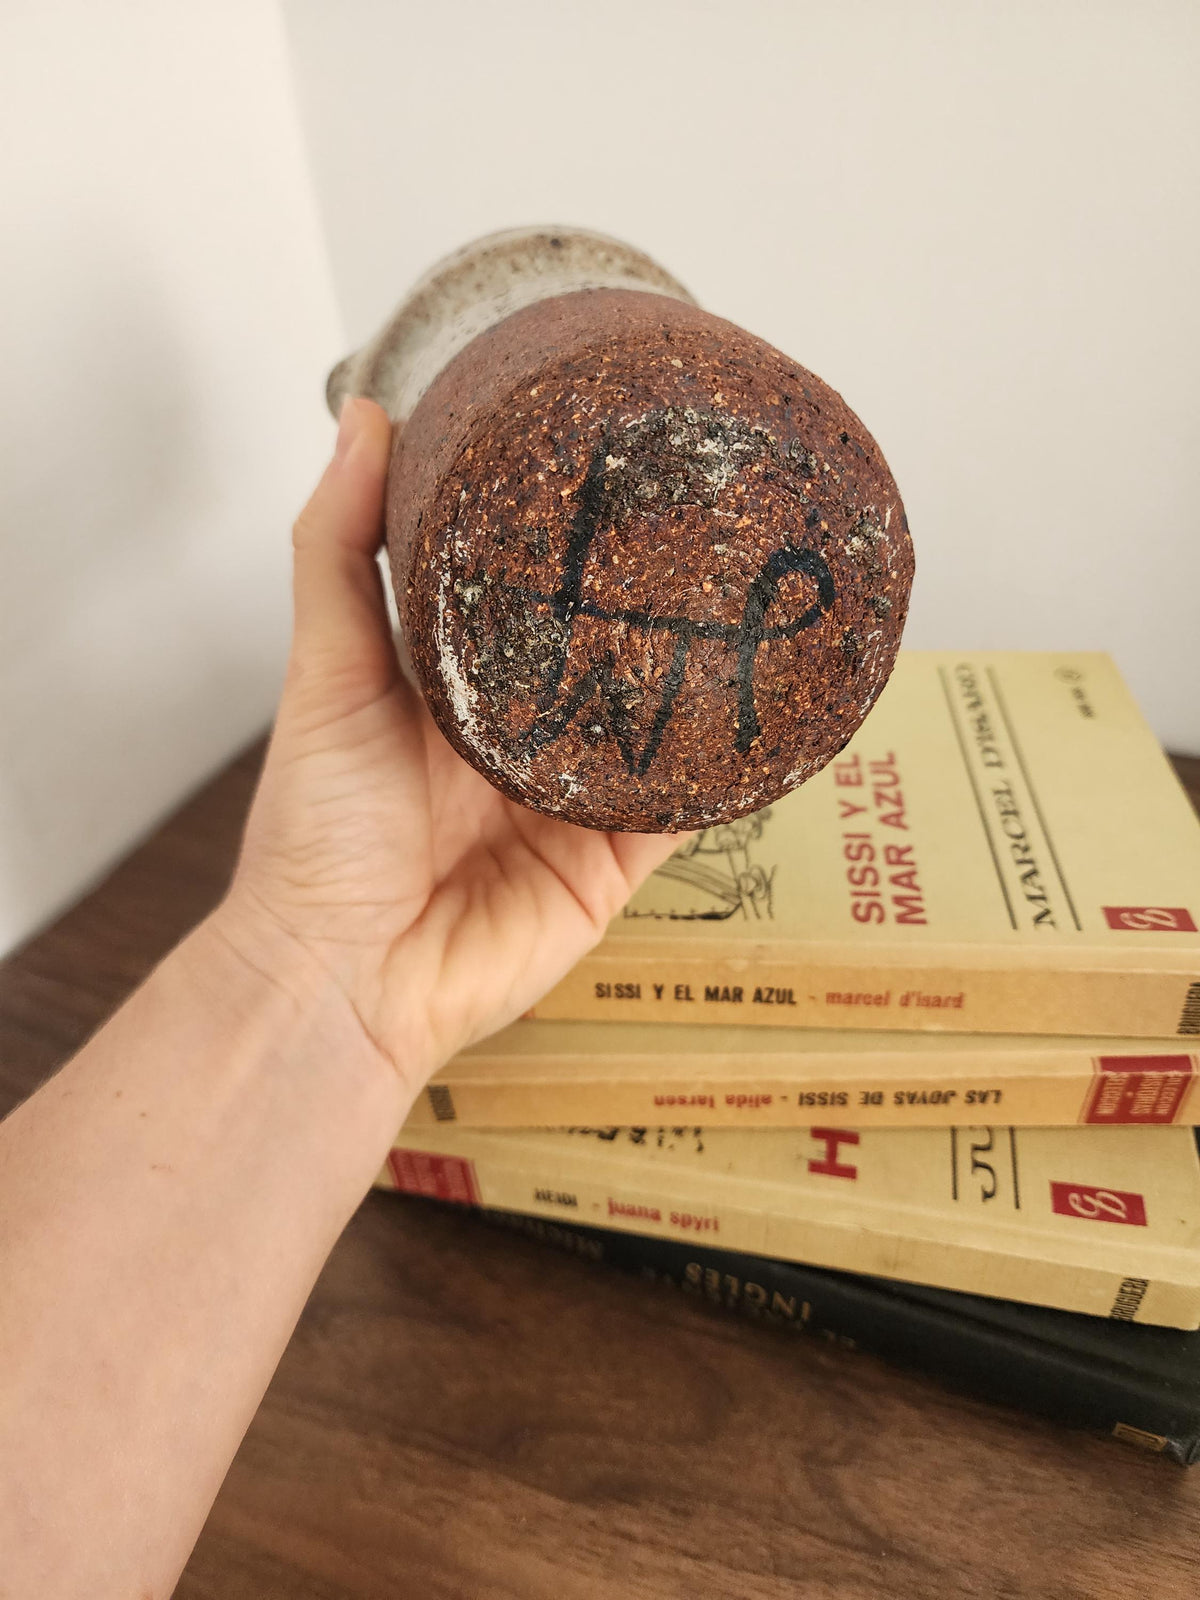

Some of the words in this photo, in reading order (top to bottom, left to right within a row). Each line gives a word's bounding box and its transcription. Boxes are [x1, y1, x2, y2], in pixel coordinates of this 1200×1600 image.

[834, 753, 864, 788] EL
[869, 752, 910, 831] AZUL
[838, 800, 867, 819] Y
[992, 780, 1055, 928] MARCEL
[843, 832, 886, 925] SISSI
[884, 845, 928, 925] MAR
[595, 982, 640, 1000] SISSI
[653, 984, 664, 1000] Y
[674, 985, 694, 1001] EL
[704, 985, 744, 1003] MAR
[752, 986, 797, 1005] AZUL
[826, 989, 890, 1008] marcel
[654, 1094, 715, 1109] larsen
[725, 1093, 772, 1108] alida
[799, 1091, 848, 1106] SISSI
[860, 1091, 883, 1105] DE
[895, 1090, 956, 1105] JOYAS
[965, 1089, 1002, 1104] LAS
[535, 1188, 578, 1207] HEIDI
[608, 1197, 661, 1221] juana
[670, 1211, 720, 1232] spyri
